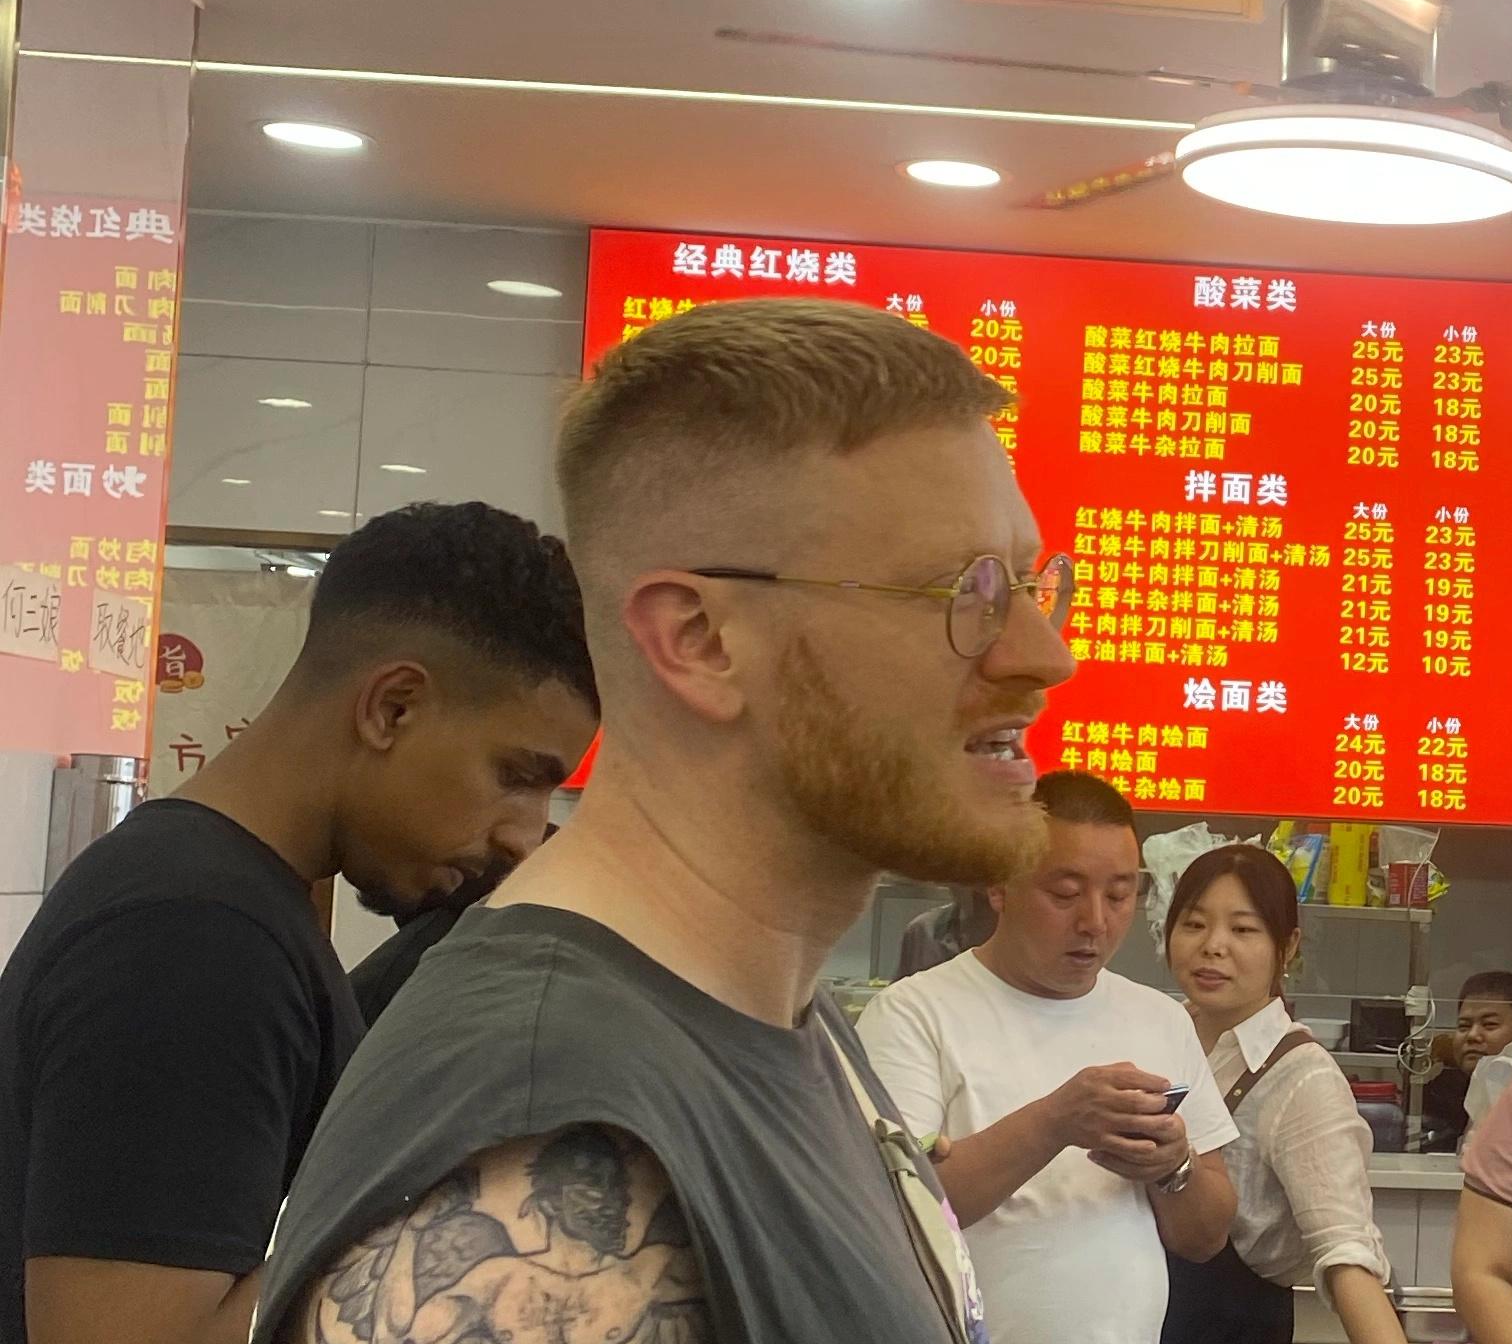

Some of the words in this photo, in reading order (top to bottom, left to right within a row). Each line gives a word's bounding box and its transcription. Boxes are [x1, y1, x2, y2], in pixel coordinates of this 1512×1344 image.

[673, 243, 856, 286] 经典红烧类
[885, 293, 923, 313] 大份
[980, 300, 1016, 319] 小份
[1194, 275, 1296, 312] 酸菜类
[971, 318, 1023, 342] 20元
[1085, 325, 1280, 358] 酸菜红烧牛肉拉面
[1352, 340, 1403, 362] 25元
[1434, 345, 1484, 366] 23元
[1361, 320, 1396, 340] 大份
[1443, 325, 1477, 344] 小份
[1083, 352, 1303, 385] 酸菜红烧牛肉刀削面
[1082, 378, 1228, 408] 酸菜牛肉拉面
[1350, 393, 1401, 415] 20元
[1434, 398, 1481, 419] 18元
[1081, 405, 1251, 435] 酸菜牛肉刀削面
[1080, 431, 1226, 460] 酸菜牛杂拉面
[1184, 470, 1287, 506] 拌面类
[1075, 507, 1282, 539] 红烧牛肉拌面+清汤
[1344, 522, 1394, 543] 25元
[1425, 525, 1476, 547] 23元
[1353, 502, 1388, 520] 大份
[1435, 506, 1469, 524] 小份
[1074, 533, 1330, 567] 红烧牛肉拌刀削面+清汤
[1073, 559, 1280, 591] 白切牛肉拌面+清汤
[1342, 574, 1392, 595] 21元
[1425, 578, 1474, 599] 19元
[1071, 586, 1279, 617] 五香牛杂拌面+清汤
[1070, 612, 1278, 643] 牛肉拌刀削面+清汤
[1068, 638, 1228, 667] 葱油拌面+清汤
[1341, 652, 1388, 673] 12元
[1422, 656, 1471, 676] 10元
[1183, 677, 1287, 713] 烩面类
[1062, 720, 1208, 749] 红烧牛肉烩面
[1336, 734, 1386, 755] 24元
[1418, 737, 1468, 758] 22元
[1344, 713, 1379, 731] 大份
[1427, 717, 1461, 737] 小份
[1061, 747, 1158, 773] 牛肉烩面
